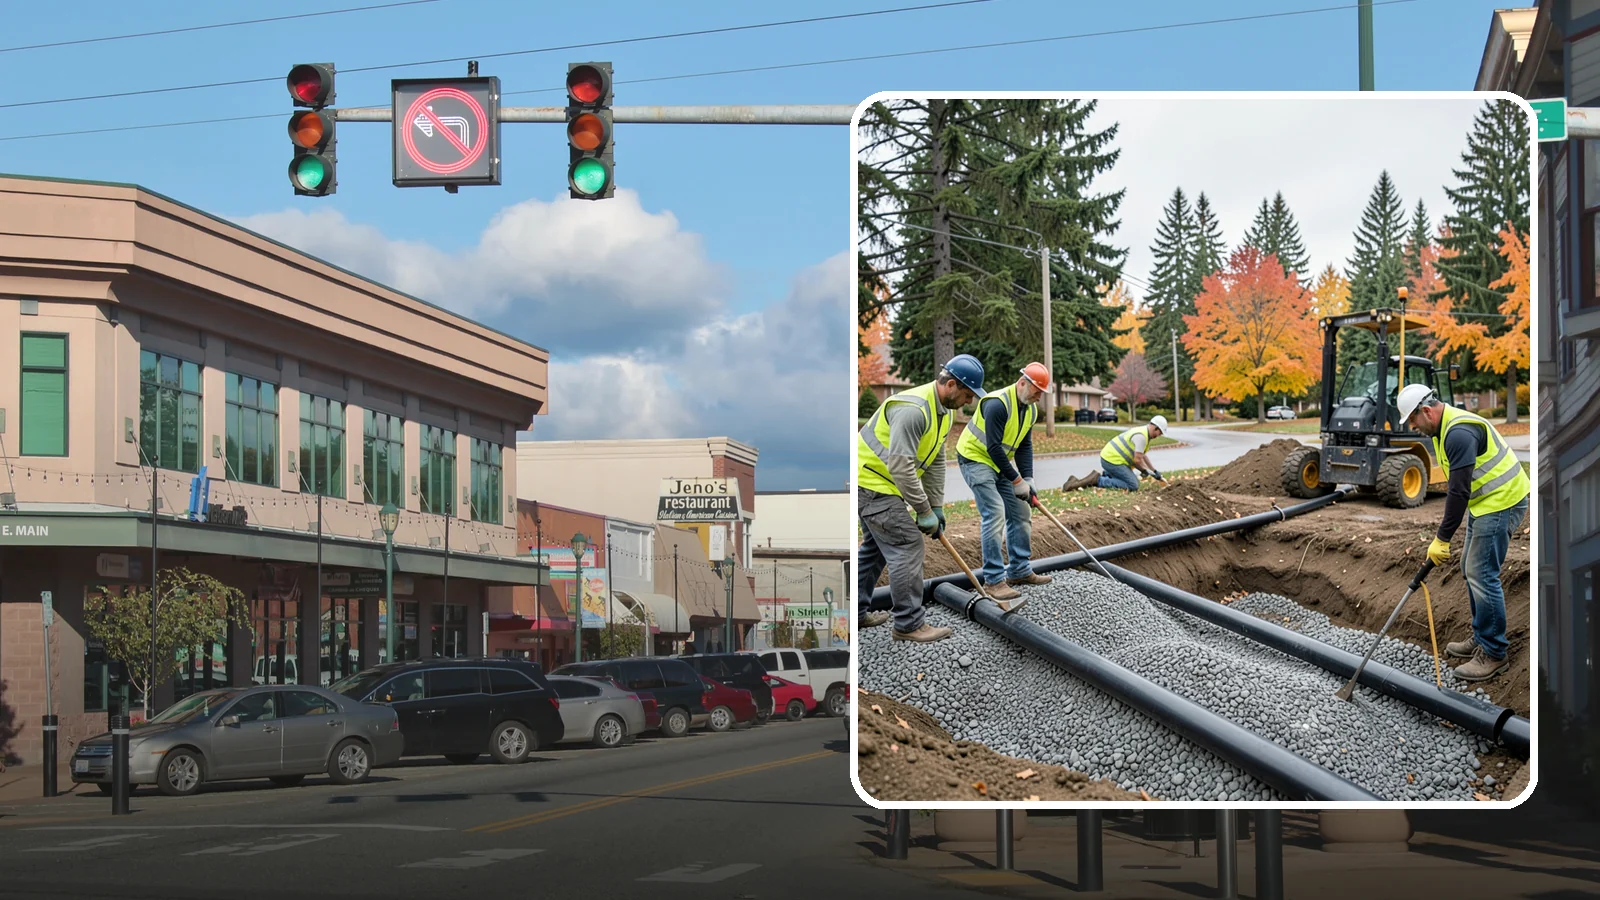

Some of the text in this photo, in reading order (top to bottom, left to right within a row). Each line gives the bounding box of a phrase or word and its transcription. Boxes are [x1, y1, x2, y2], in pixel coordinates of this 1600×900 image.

[670, 480, 727, 494] Jeno's
[665, 496, 731, 509] restaurant
[659, 510, 681, 519] Italian
[686, 510, 714, 519] American
[715, 510, 737, 519] Cuisine
[2, 525, 49, 536] E. MAIN
[797, 608, 828, 617] Street
